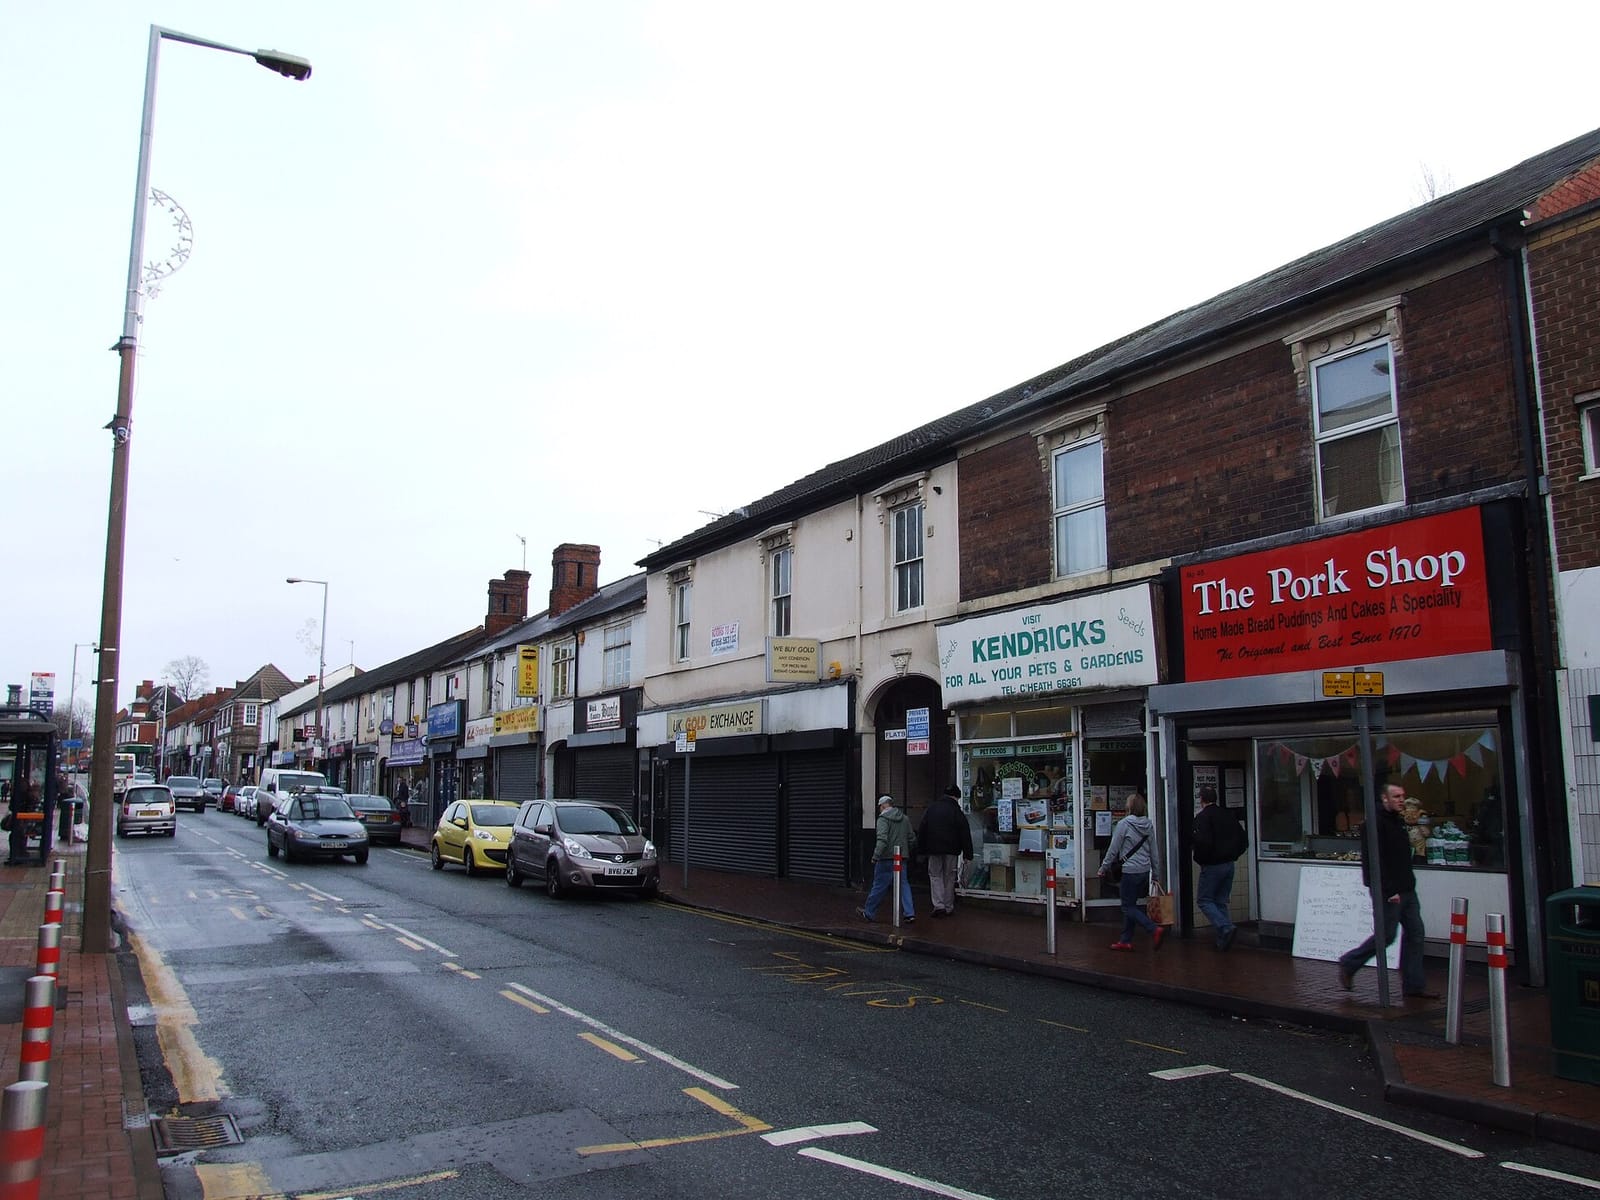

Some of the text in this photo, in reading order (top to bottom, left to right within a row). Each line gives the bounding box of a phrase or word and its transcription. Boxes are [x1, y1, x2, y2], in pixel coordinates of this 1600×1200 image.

[1192, 545, 1467, 615] The Pork Shop
[1022, 614, 1041, 625] VISIT
[1117, 608, 1145, 637] Seeds
[1192, 588, 1462, 641] Home Made Bread Puddings And Cakes A Speciality
[942, 640, 959, 669] Seeds
[972, 619, 1106, 663] KENDRICKS
[1217, 648, 1233, 660] The
[1291, 641, 1311, 653] and
[1318, 636, 1343, 649] Best
[1350, 630, 1383, 646] Since
[1389, 624, 1421, 641] 1970
[945, 650, 1143, 689] FOR ALL YOUR PETS & GARDENS
[1001, 685, 1016, 695] TEL:
[1057, 678, 1082, 689] 66361
[673, 710, 754, 733] UK GOLD EXCHANGE
[908, 709, 927, 717] PRIVATE
[1021, 743, 1058, 753] PET SUPPLIES
